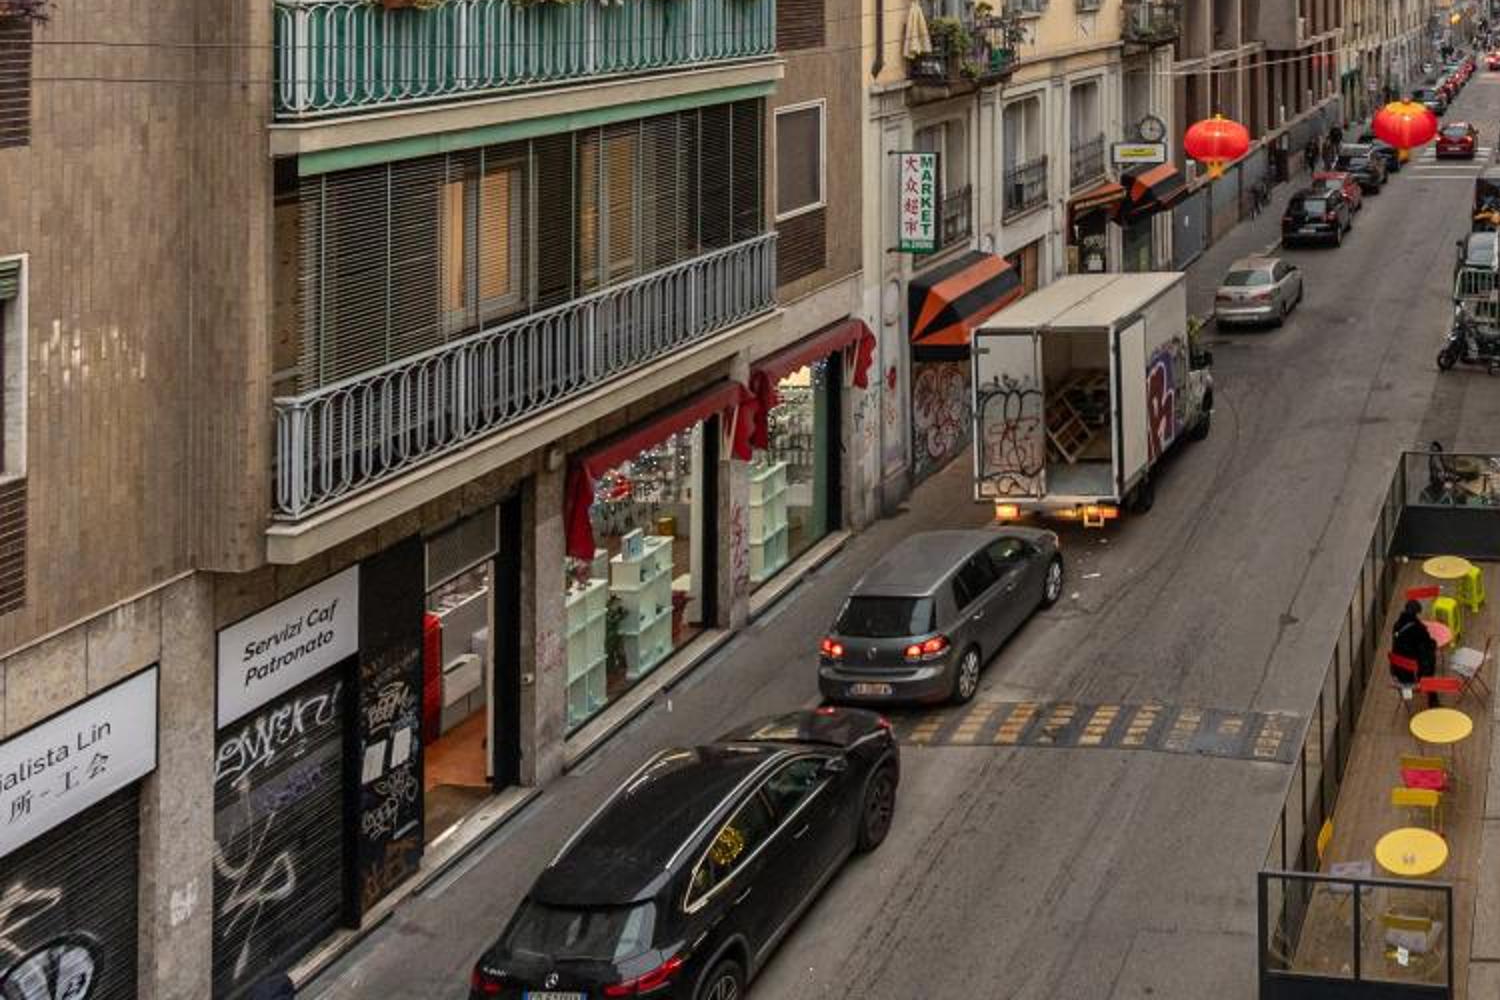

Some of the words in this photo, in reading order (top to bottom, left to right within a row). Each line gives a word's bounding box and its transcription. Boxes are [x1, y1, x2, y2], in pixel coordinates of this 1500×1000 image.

[920, 155, 933, 235] MARKET
[243, 616, 304, 662] Servizi
[307, 597, 340, 628] Caf
[244, 629, 335, 687] Patronato
[77, 721, 111, 751] Lin
